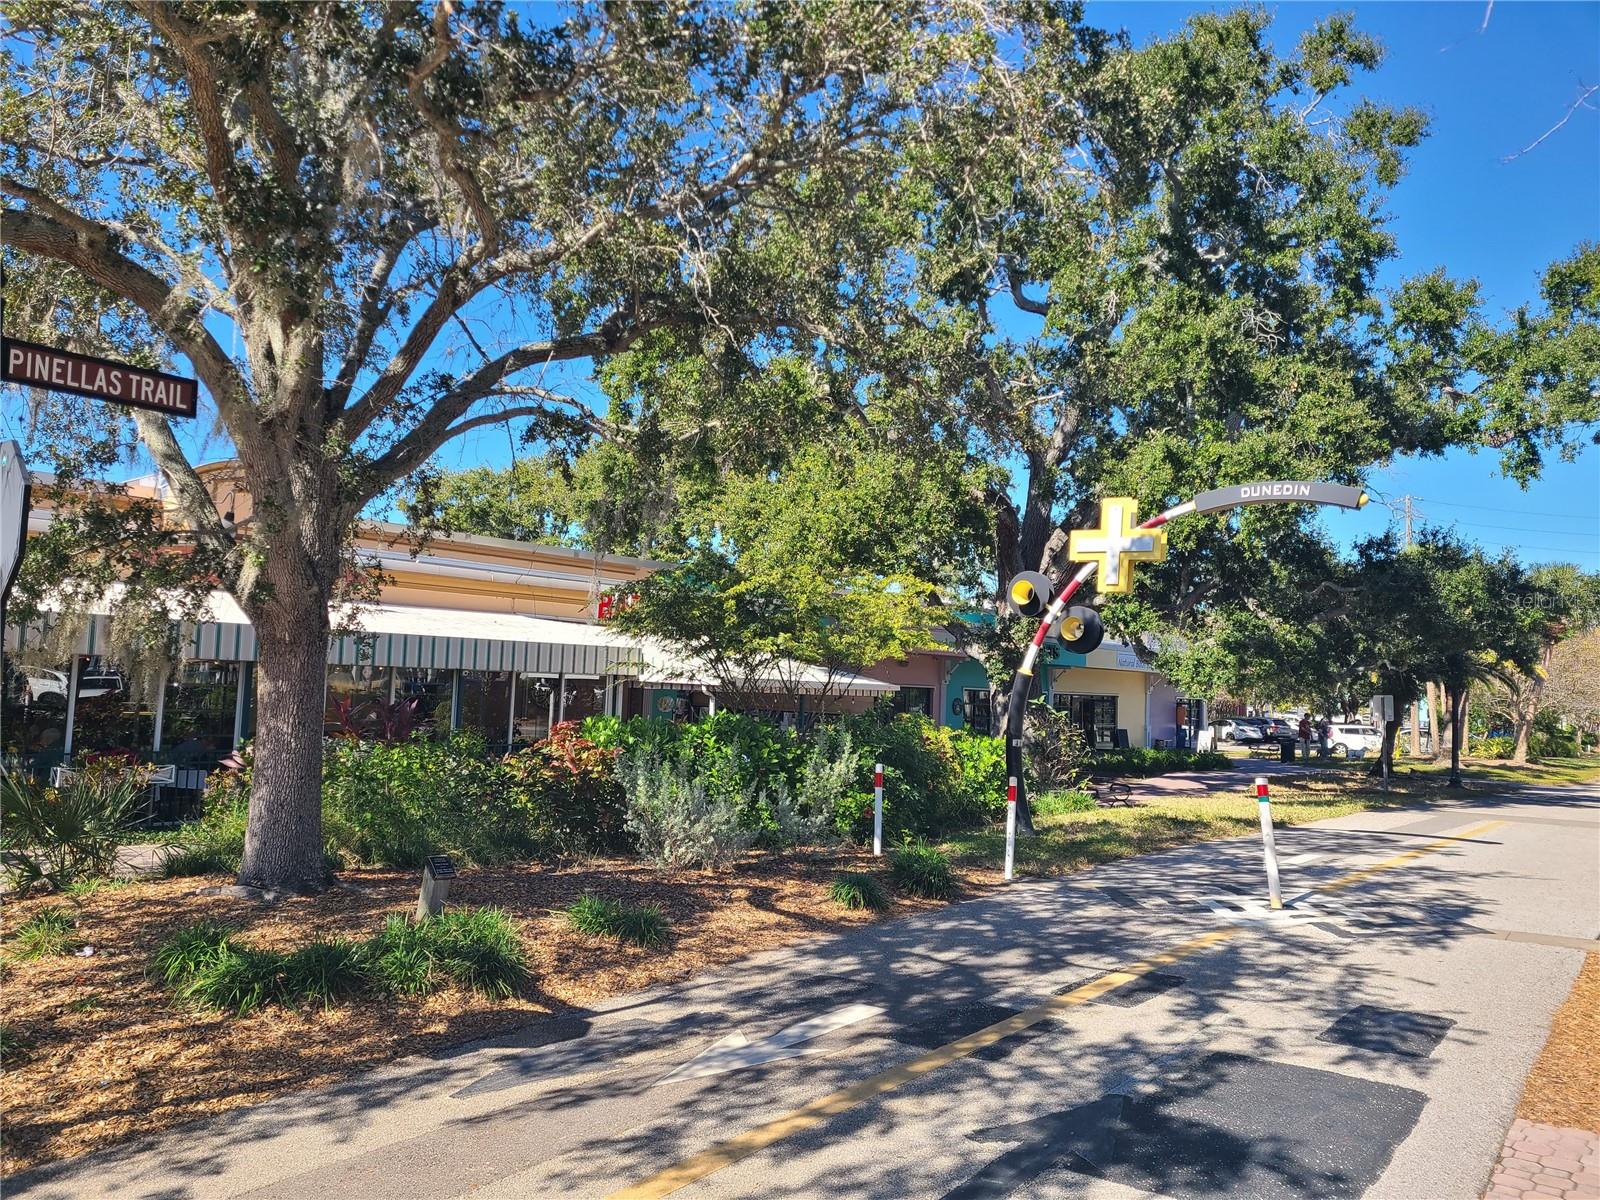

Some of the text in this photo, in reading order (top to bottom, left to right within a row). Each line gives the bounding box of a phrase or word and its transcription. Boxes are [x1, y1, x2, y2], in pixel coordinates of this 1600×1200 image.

[8, 349, 187, 409] PINELLAS TRAIL
[1240, 484, 1311, 498] DUNEDIN
